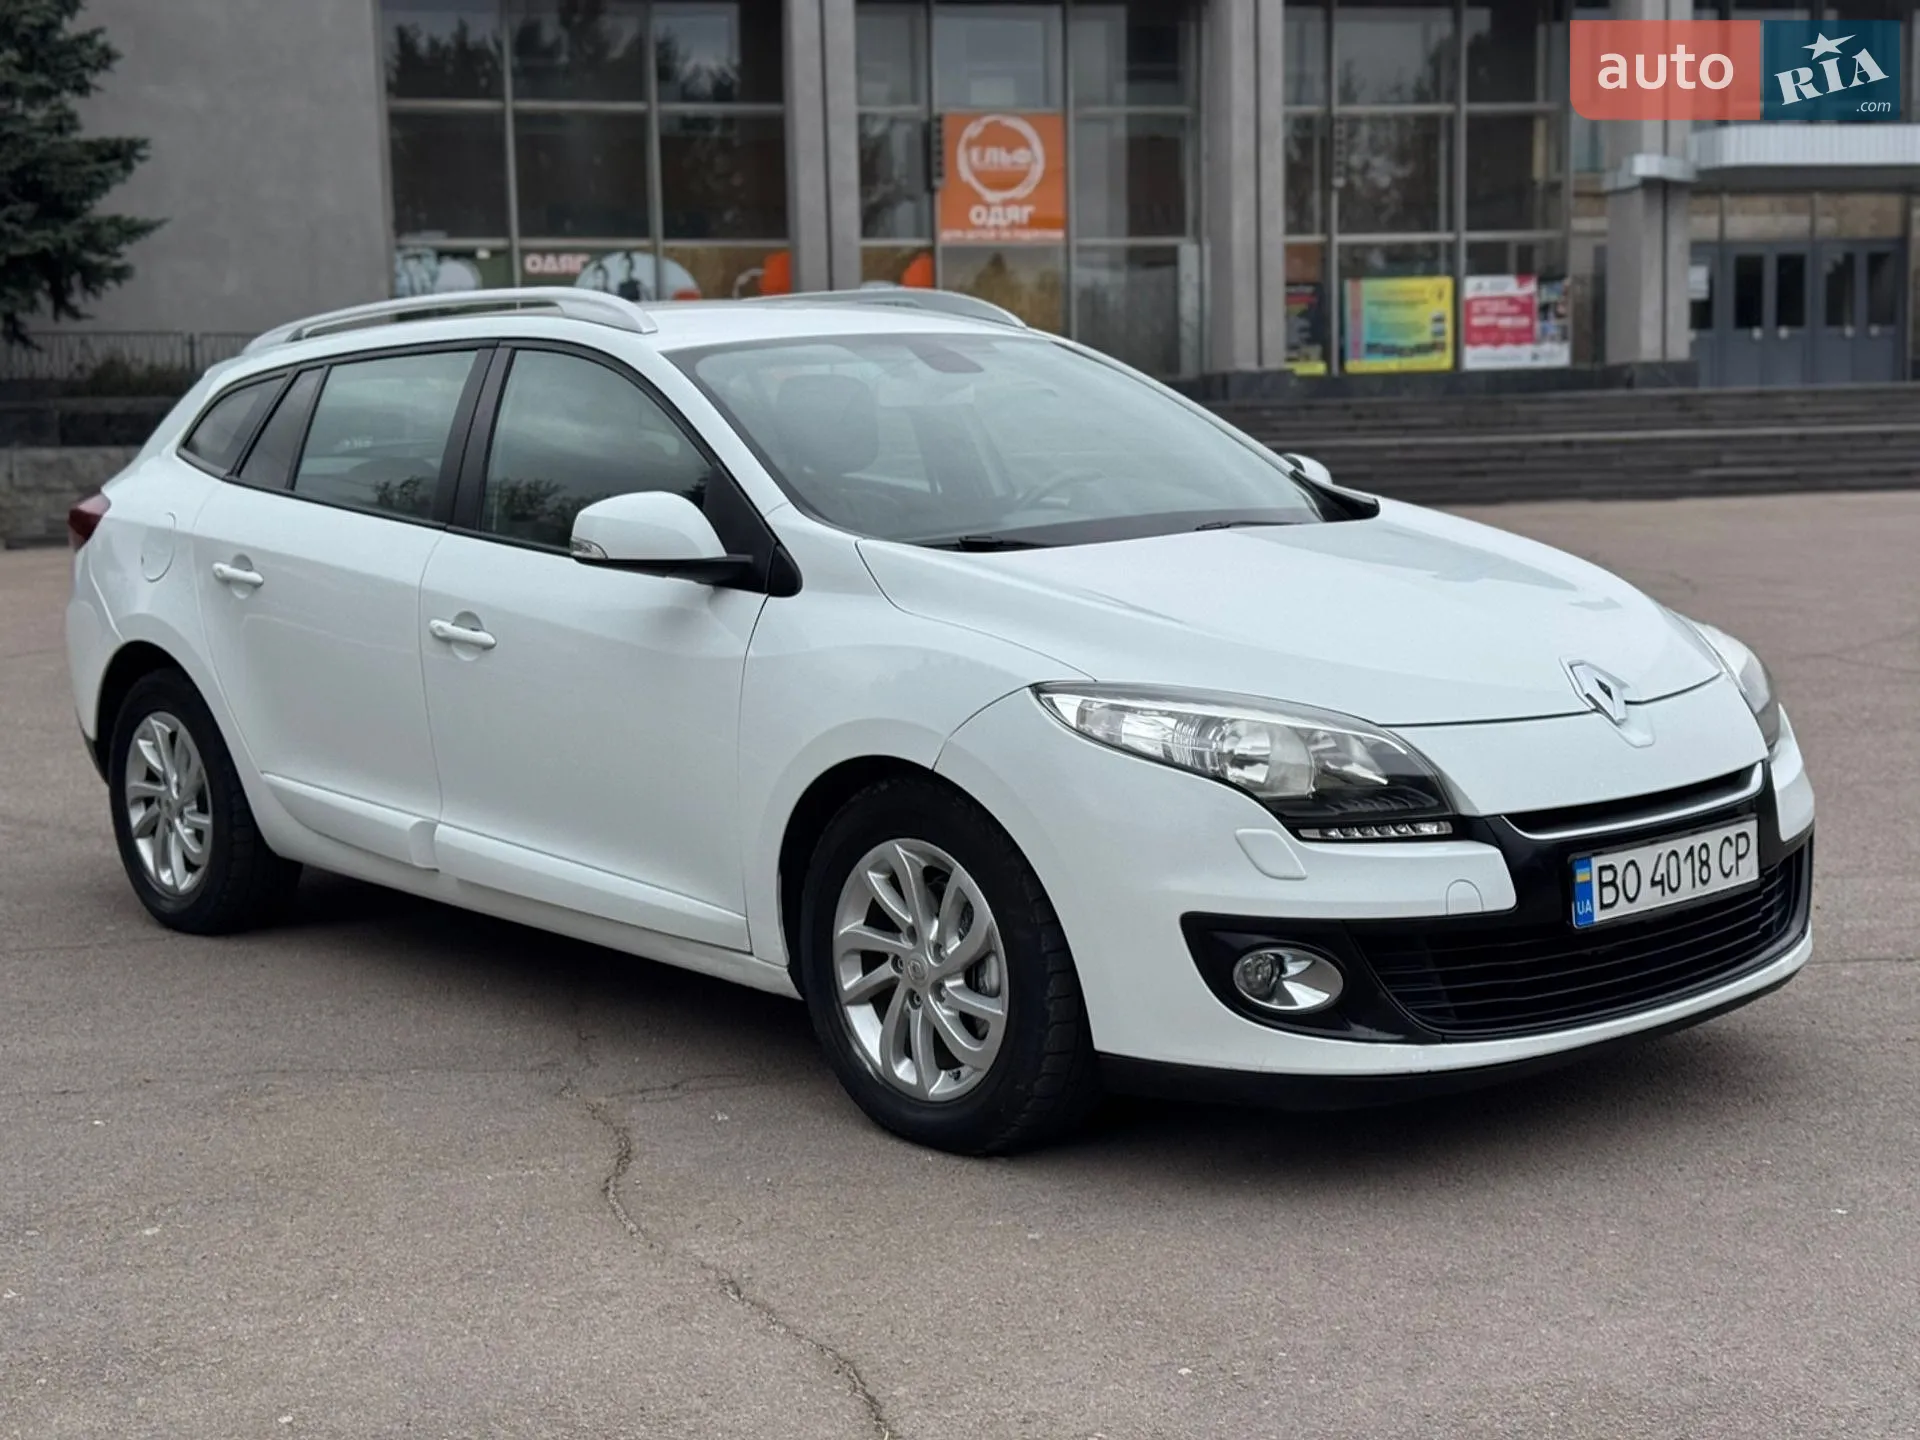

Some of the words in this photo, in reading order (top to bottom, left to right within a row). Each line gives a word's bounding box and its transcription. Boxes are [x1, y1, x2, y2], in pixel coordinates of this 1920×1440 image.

[1598, 859, 1641, 911] BO
[1650, 842, 1712, 897] 4018
[1718, 831, 1751, 879] CP
[1577, 899, 1593, 916] UA
